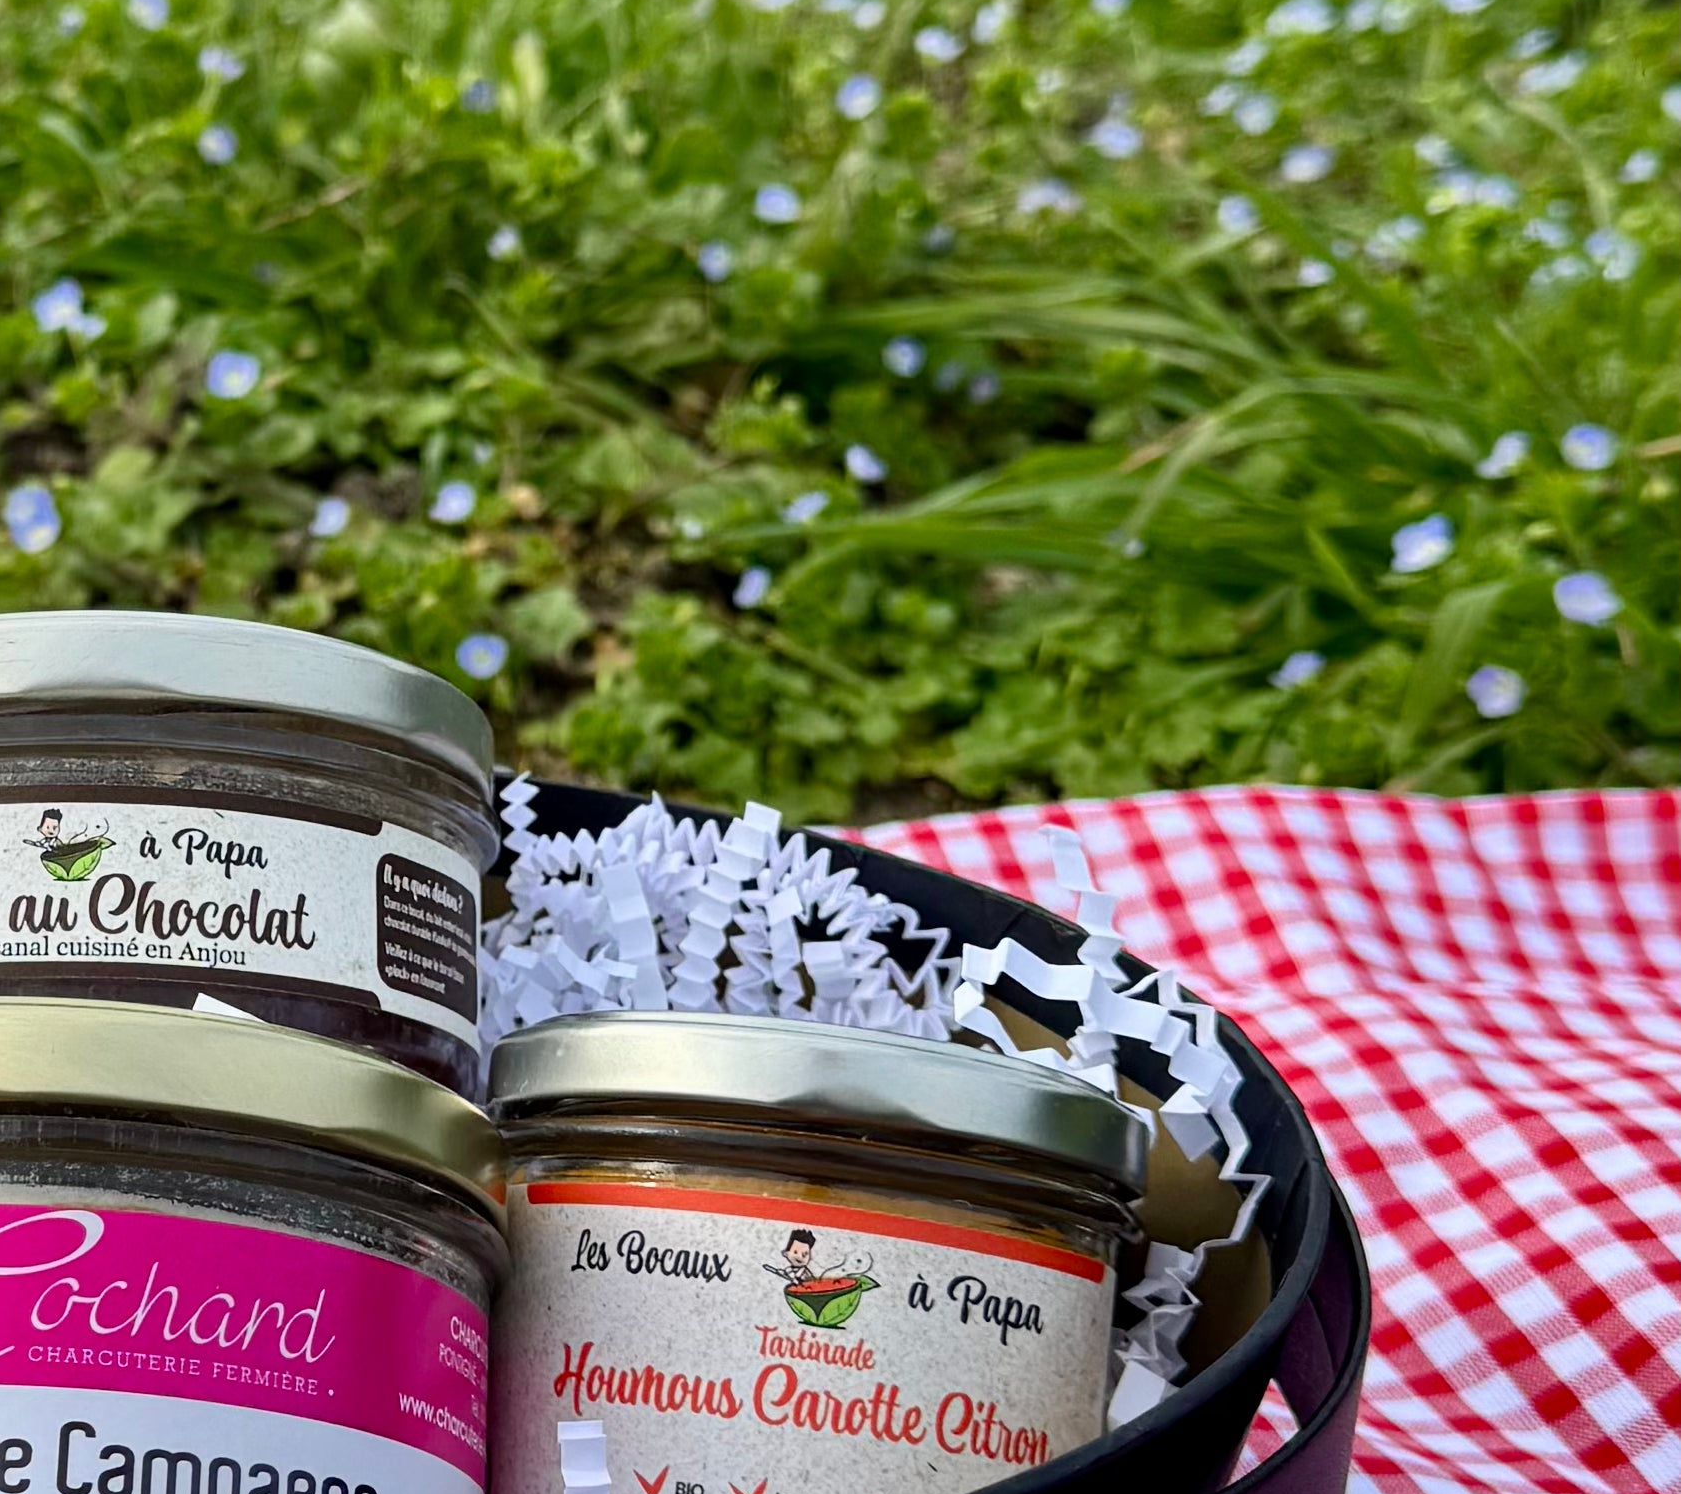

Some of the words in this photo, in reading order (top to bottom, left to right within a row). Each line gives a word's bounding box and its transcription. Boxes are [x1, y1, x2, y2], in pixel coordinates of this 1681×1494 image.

[139, 828, 161, 860] à
[171, 827, 269, 879] Papa
[9, 895, 78, 935] au
[87, 872, 316, 950] Chocolat
[56, 935, 139, 960] cuisiné
[145, 942, 175, 960] en
[178, 940, 247, 969] Anjou
[570, 1228, 611, 1274] Les
[616, 1230, 731, 1283] Bocaux
[908, 1273, 934, 1313] à
[947, 1275, 1044, 1345] Papa
[28, 1344, 202, 1377] CHARCUTERIE
[210, 1363, 320, 1397] FERMIÈRE
[755, 1325, 876, 1371] Tartinade
[553, 1341, 744, 1418] Houmous
[752, 1363, 927, 1446] Carotte
[935, 1392, 1053, 1466] Citron
